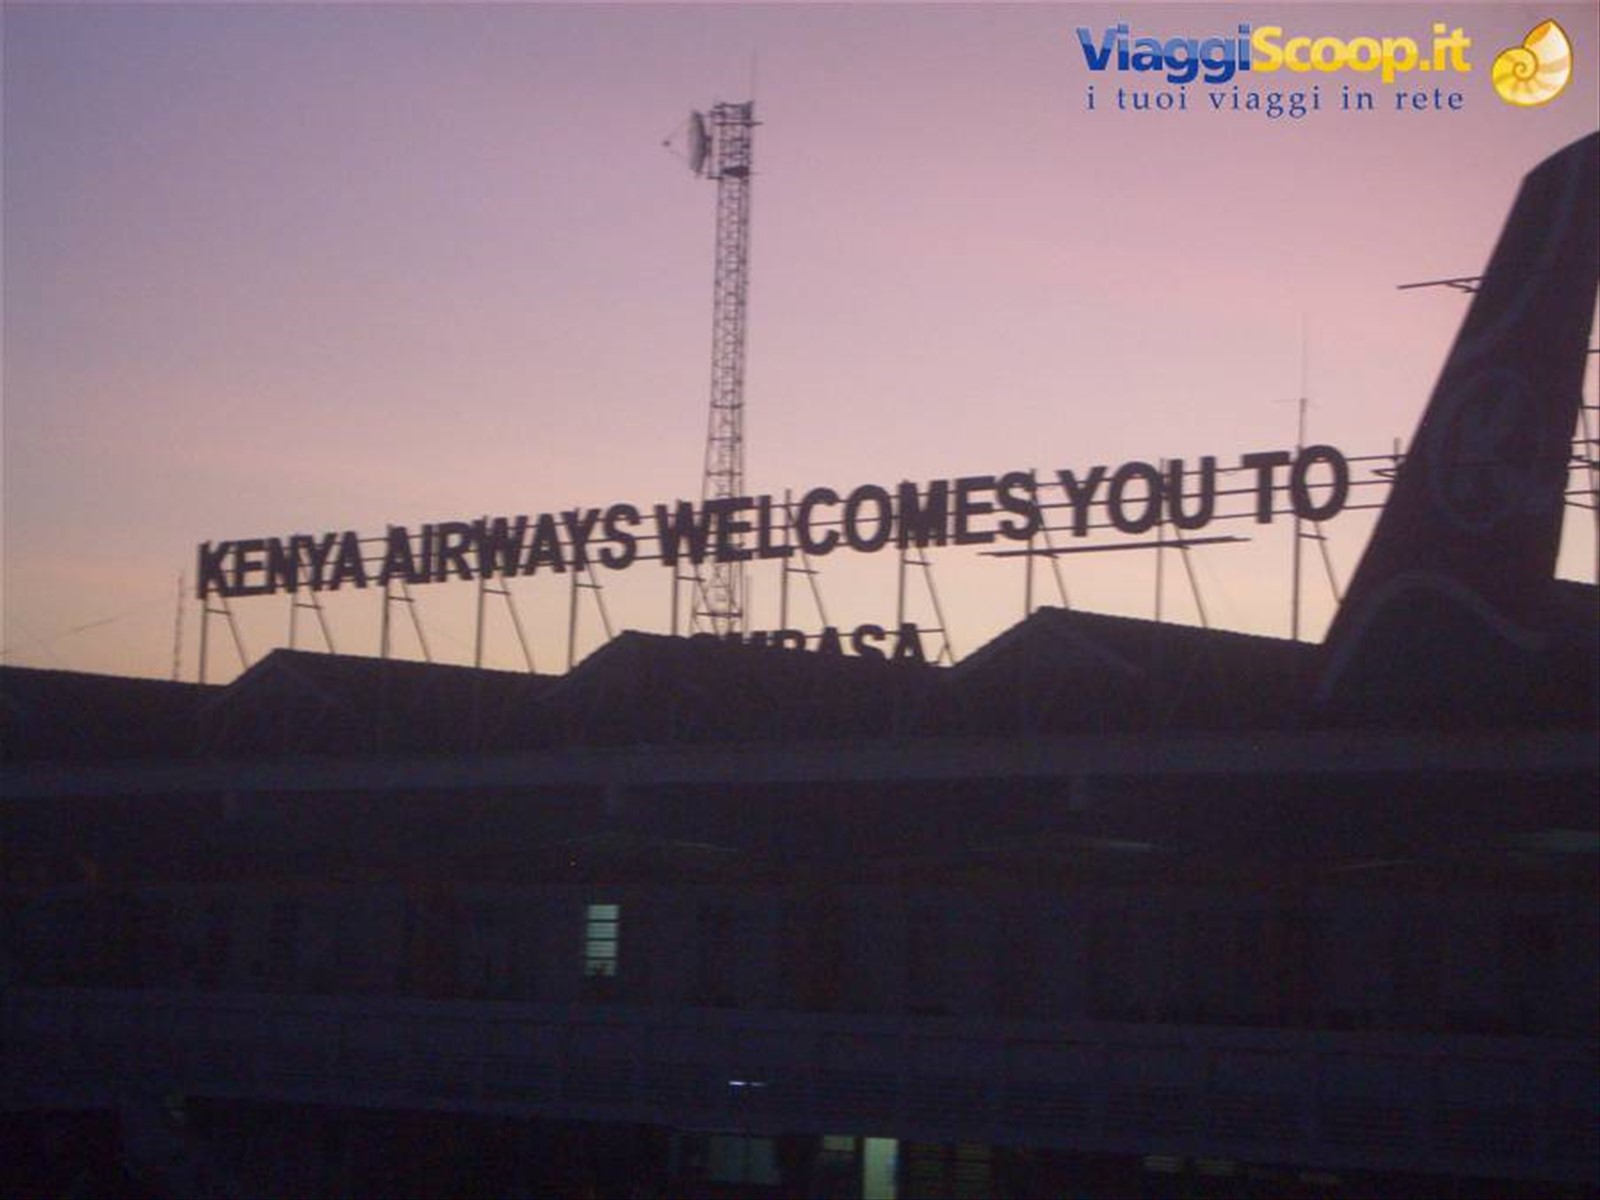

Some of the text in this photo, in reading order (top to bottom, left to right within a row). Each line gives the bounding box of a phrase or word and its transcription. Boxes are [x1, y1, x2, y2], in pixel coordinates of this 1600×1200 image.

[196, 445, 1349, 598] KENYA AIRWAYS WELCOMES YOU TO
